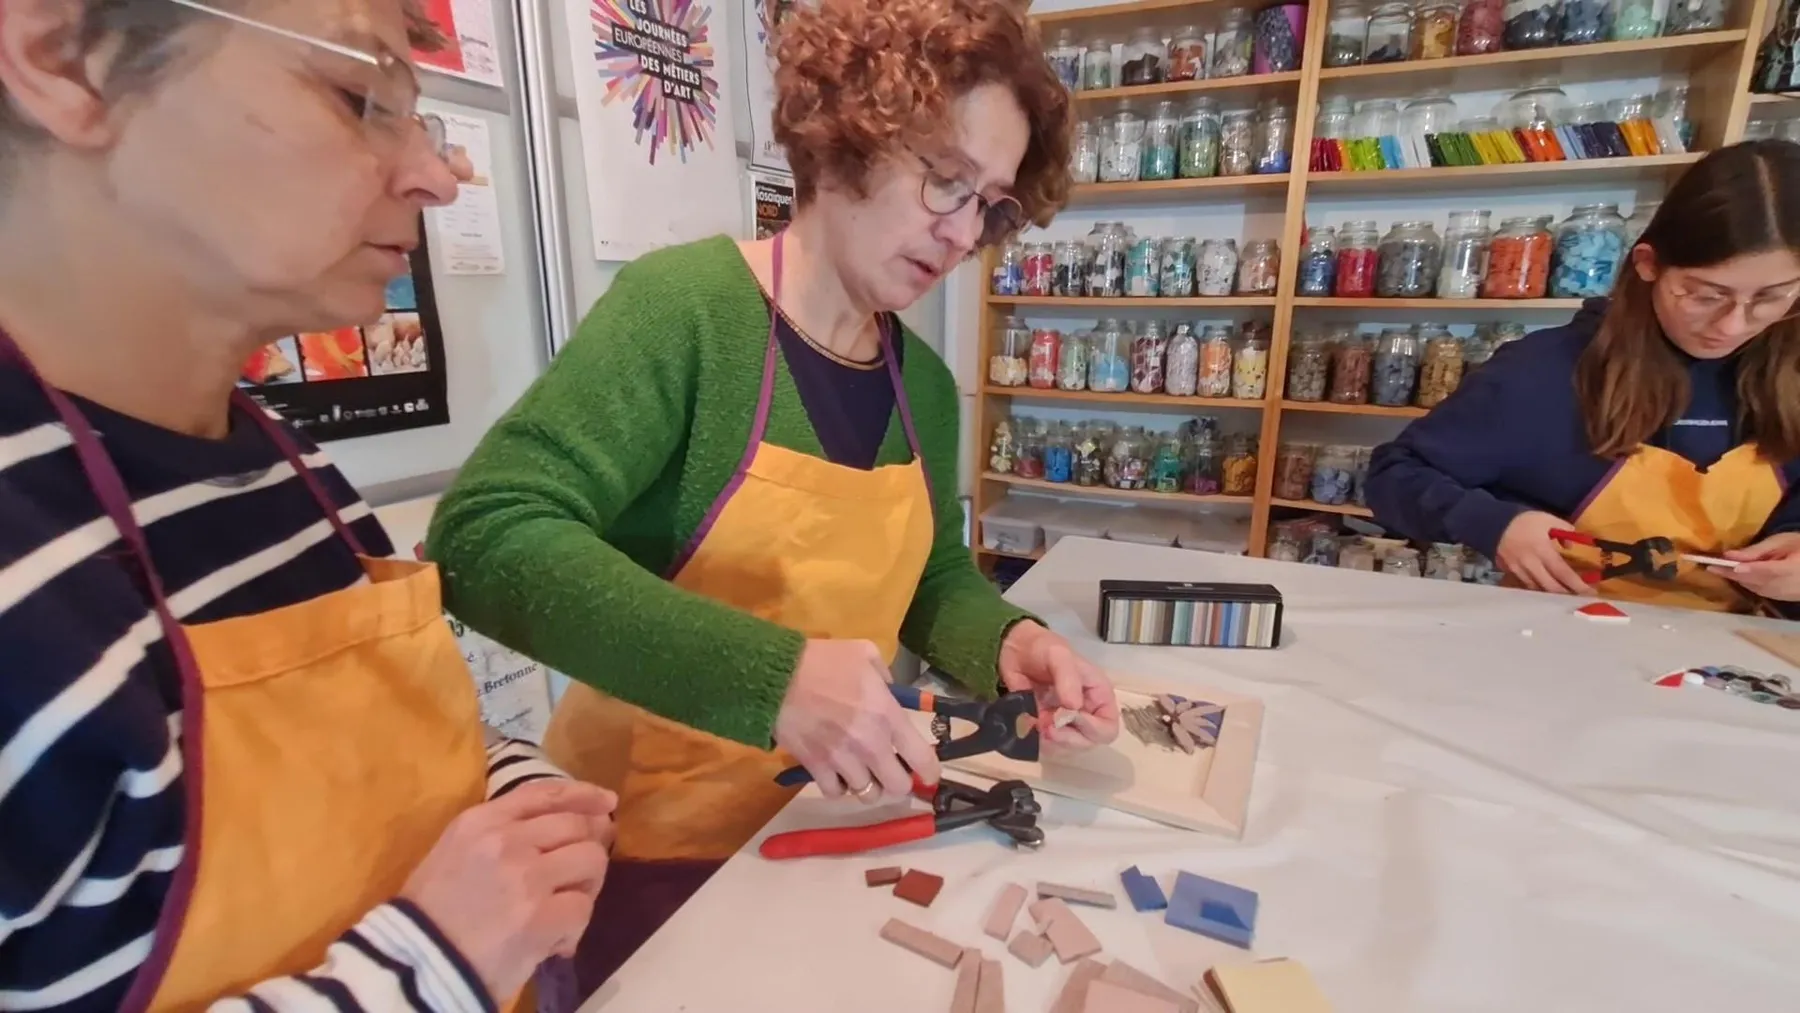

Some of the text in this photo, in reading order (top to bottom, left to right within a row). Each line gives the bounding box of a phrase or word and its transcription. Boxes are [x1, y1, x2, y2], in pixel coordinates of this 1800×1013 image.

[629, 0, 647, 14] LES
[614, 27, 682, 62] EUROPÉENNES
[637, 18, 688, 47] JOURNÉES
[641, 55, 700, 85] DES MÉTIERS
[664, 80, 691, 99] D'ART
[484, 663, 538, 693] Bretonne
